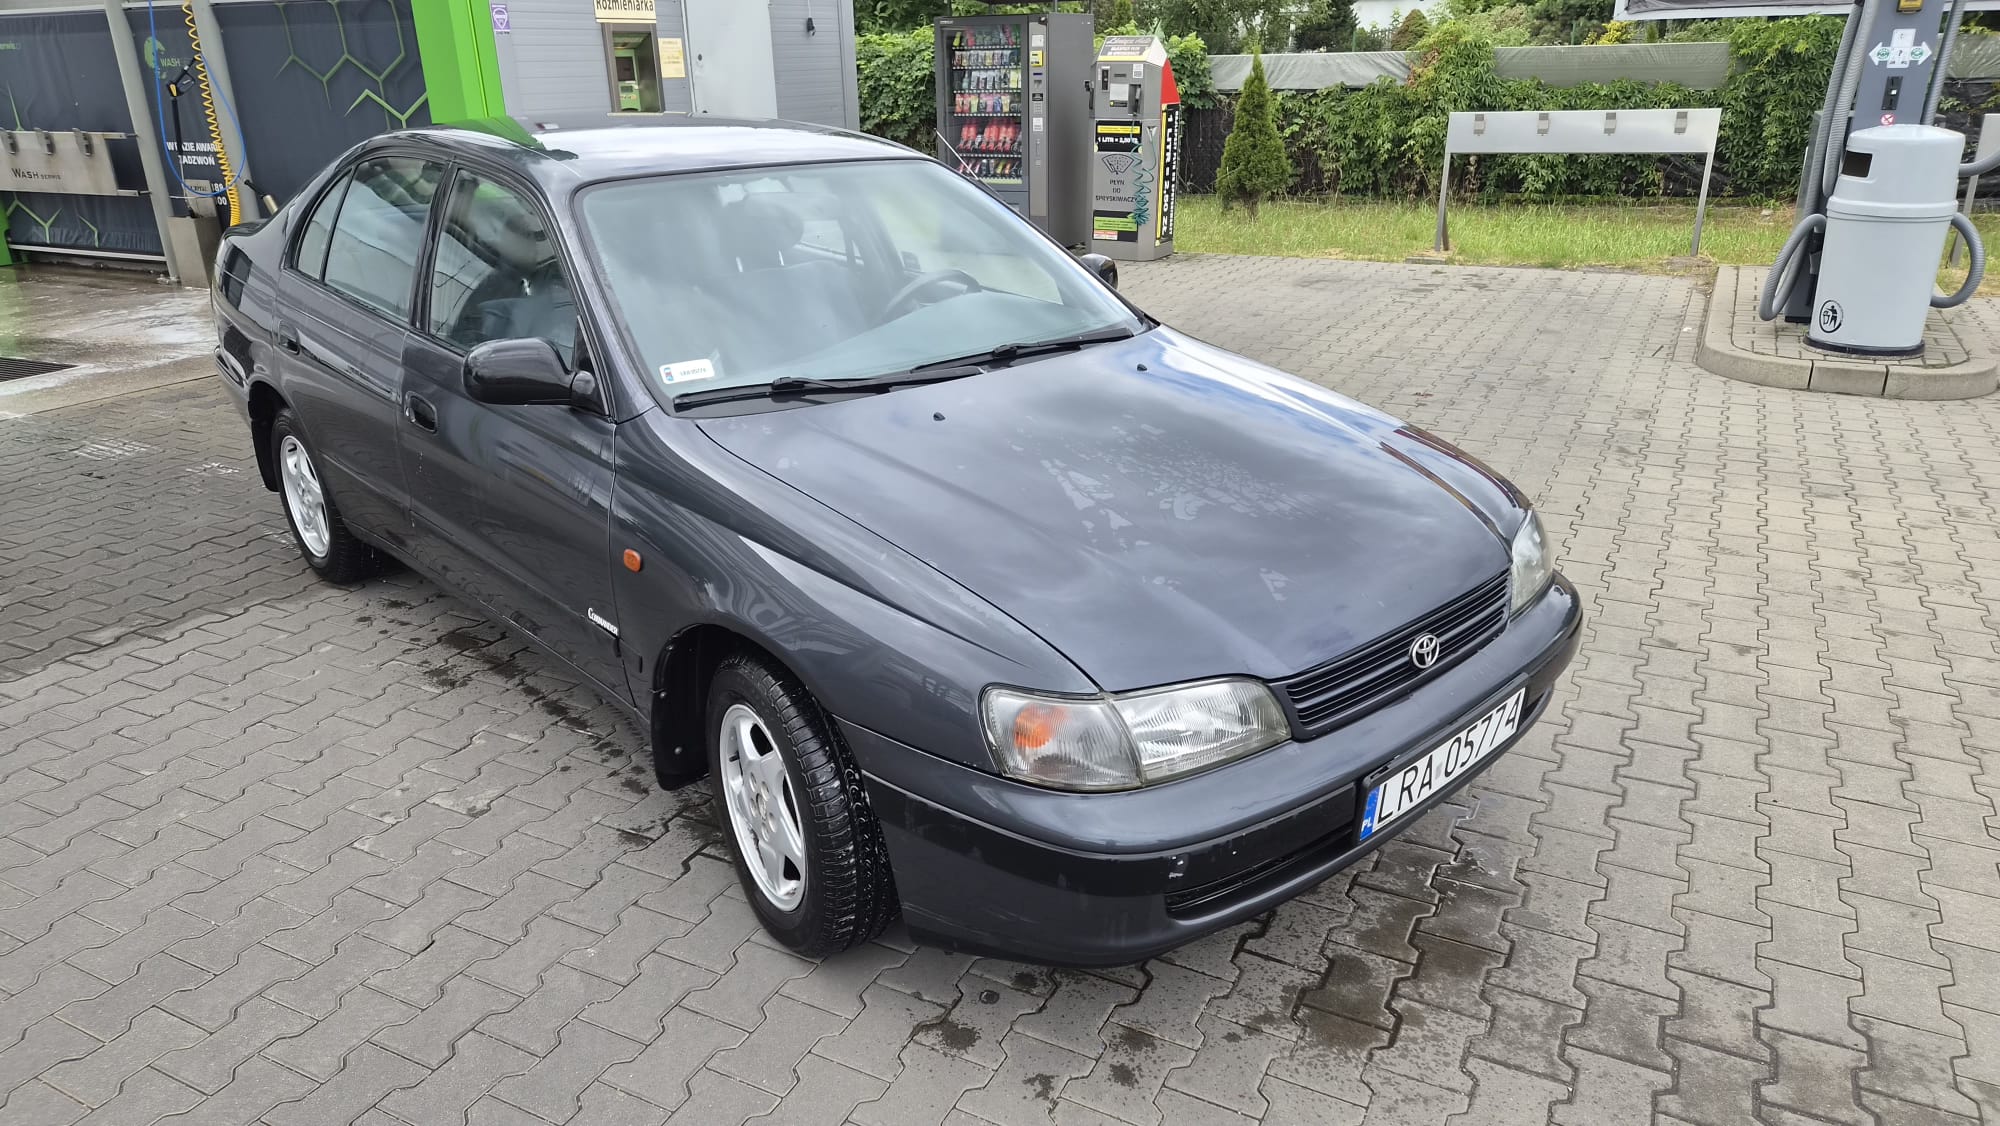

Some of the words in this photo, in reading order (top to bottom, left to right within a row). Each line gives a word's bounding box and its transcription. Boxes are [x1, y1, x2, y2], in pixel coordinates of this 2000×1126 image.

[1377, 754, 1434, 825] LRA
[1444, 692, 1523, 778] 05774
[1361, 816, 1372, 832] PL
